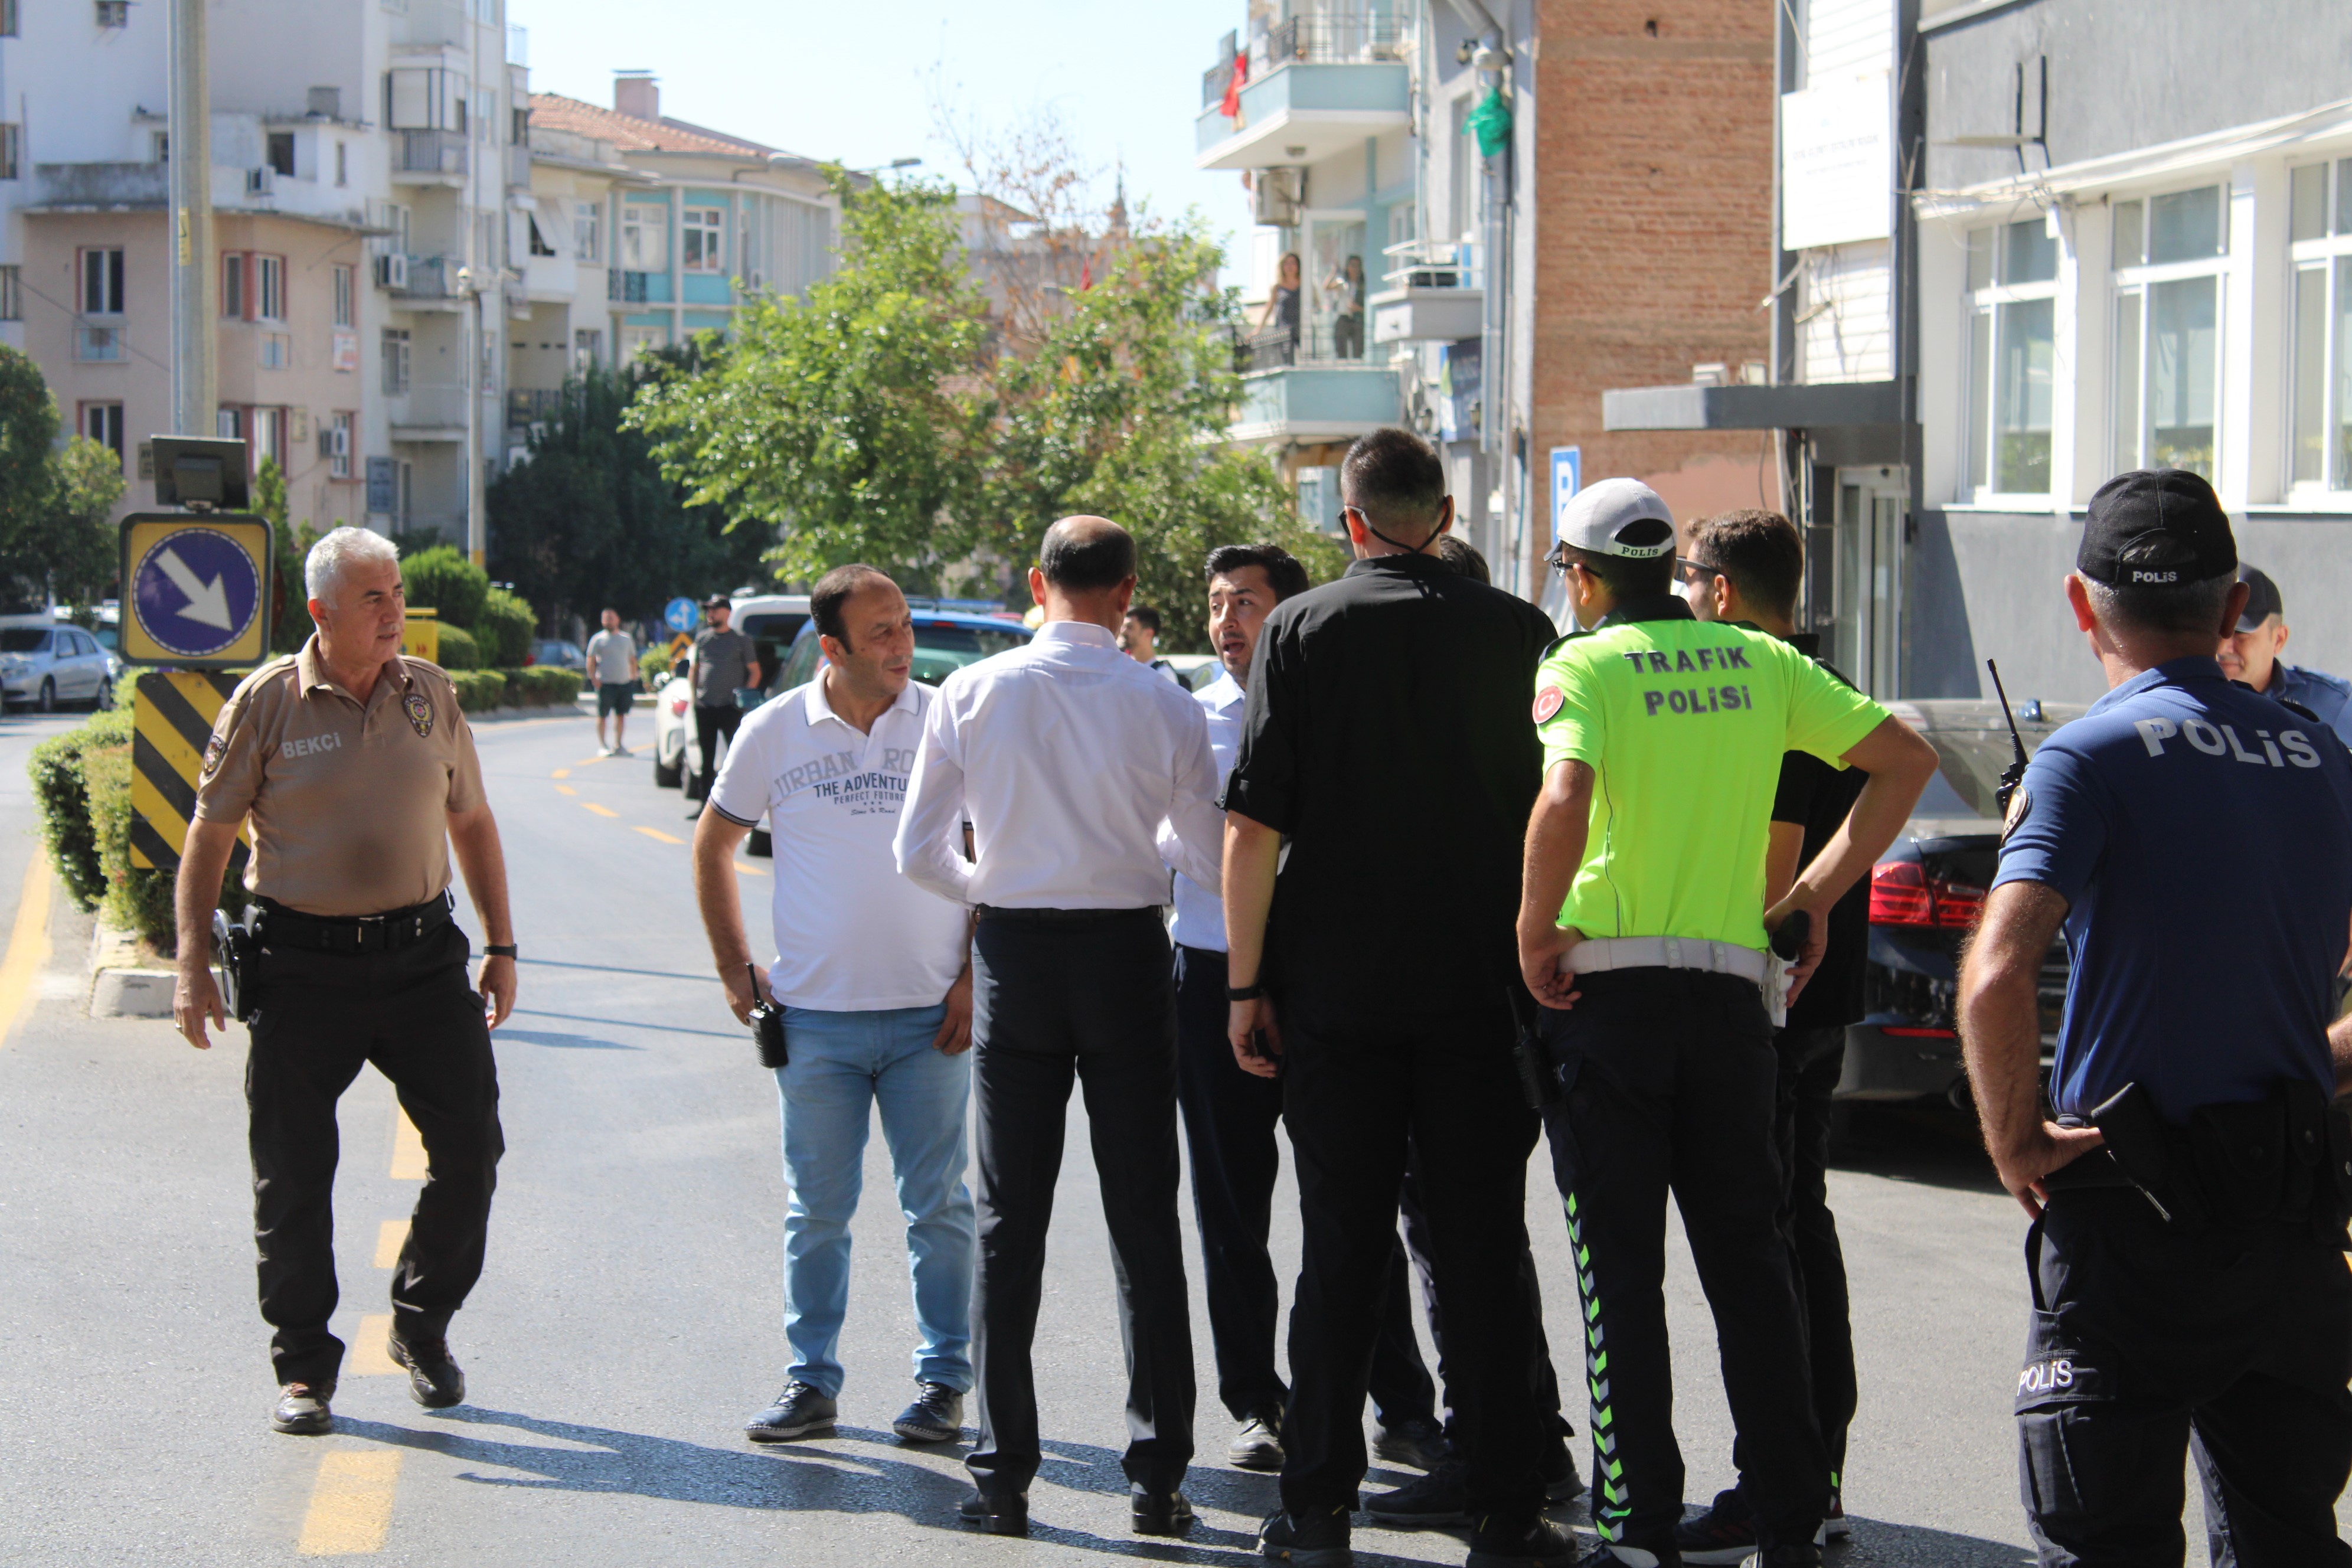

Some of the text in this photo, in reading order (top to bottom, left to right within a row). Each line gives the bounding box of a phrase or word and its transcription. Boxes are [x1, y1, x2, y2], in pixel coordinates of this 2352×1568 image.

[1556, 461, 1574, 529] P
[1621, 546, 1658, 556] POLİS
[2132, 571, 2178, 583] POLİS
[1623, 646, 1752, 674] TRAFİK
[1644, 685, 1752, 716] POLİSİ
[2134, 717, 2321, 768] POLİS
[774, 748, 916, 798] URBAN RO
[814, 772, 909, 798] THE ADVENTU
[834, 791, 905, 805] PERFECT FUTURE
[2017, 1360, 2073, 1397] POLİS
